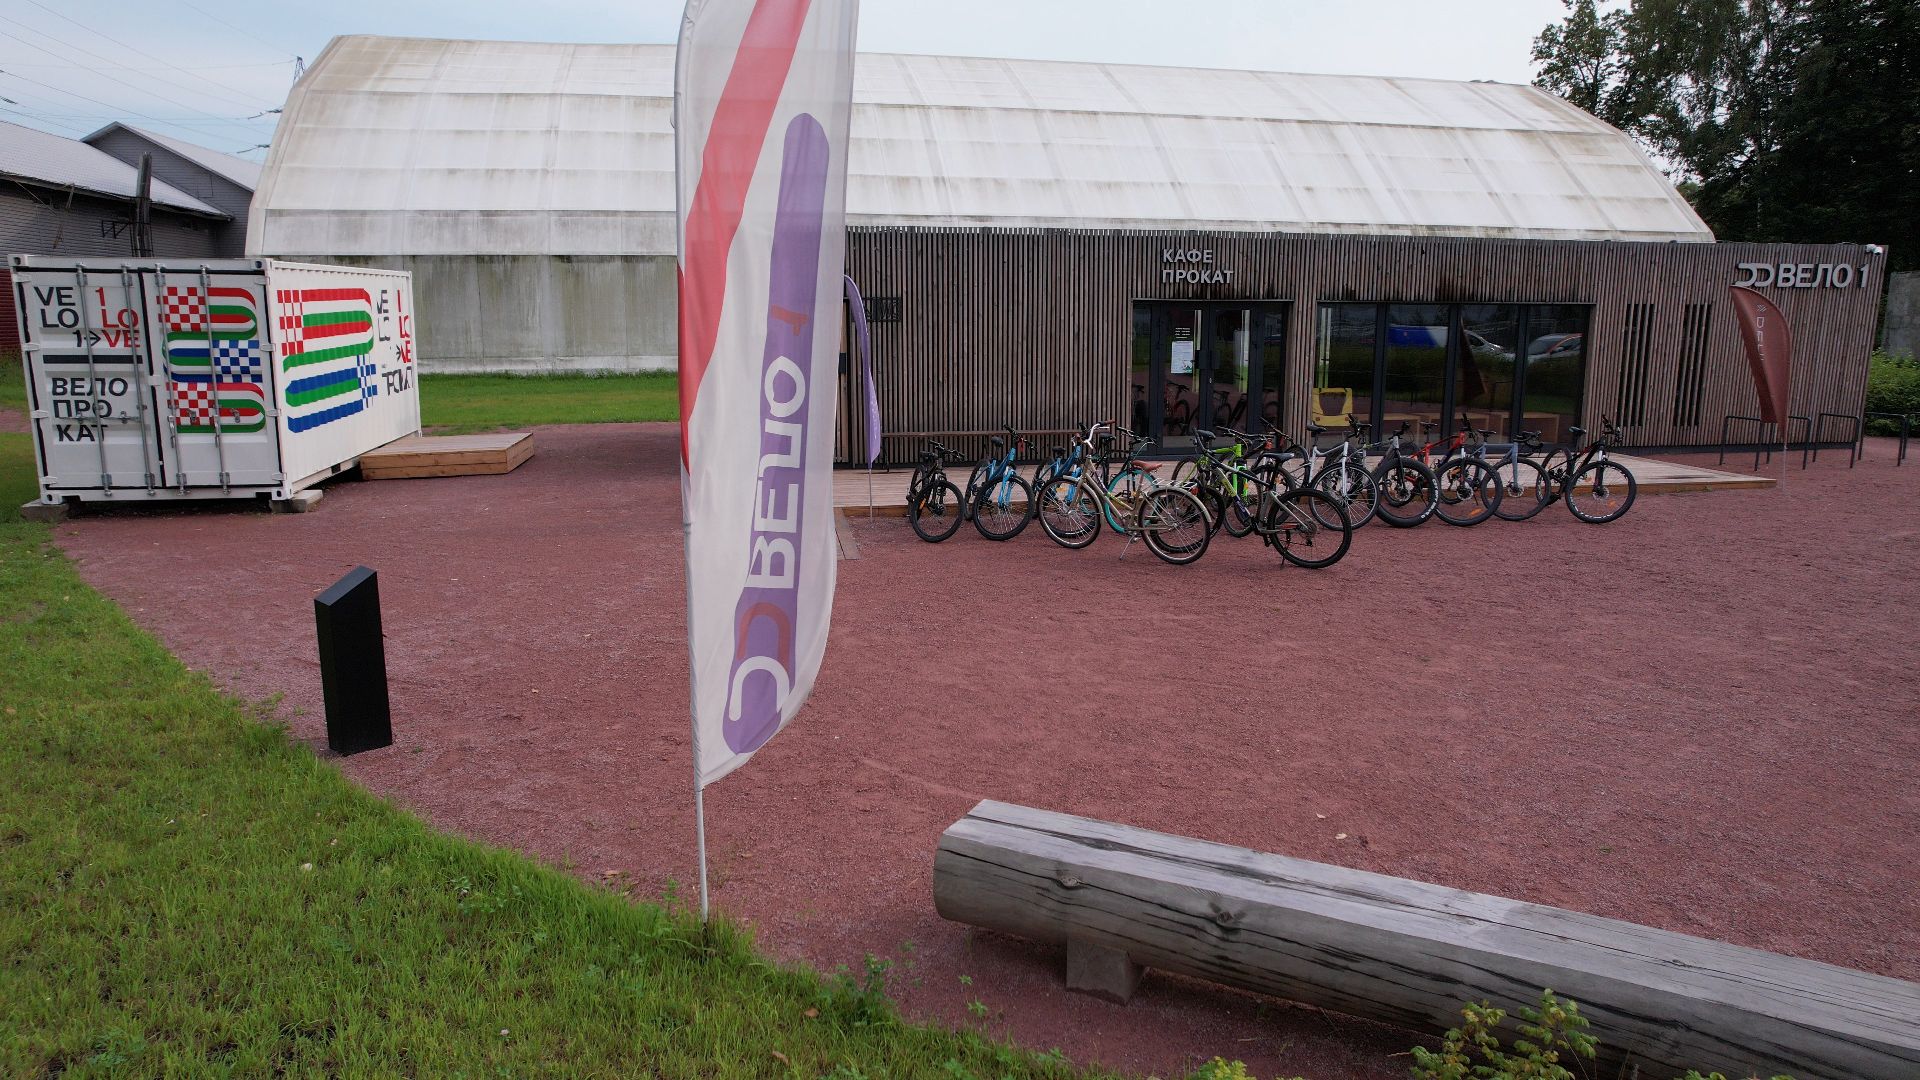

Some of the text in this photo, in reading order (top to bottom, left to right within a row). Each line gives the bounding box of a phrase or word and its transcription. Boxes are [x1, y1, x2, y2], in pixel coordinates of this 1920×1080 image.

[1162, 248, 1213, 263] КАФЕ
[1162, 269, 1234, 284] ПРОКАТ
[1776, 263, 1870, 288] ВЕЛО 1
[33, 286, 76, 307] VE
[95, 286, 106, 307] 1
[40, 307, 80, 329] LO
[101, 308, 139, 329] LO
[101, 329, 141, 348] VE
[51, 377, 129, 397] ВЕЛО
[53, 400, 112, 419] ПРО
[56, 424, 109, 442] КАТ
[744, 303, 809, 589] ВЕЛО 1
